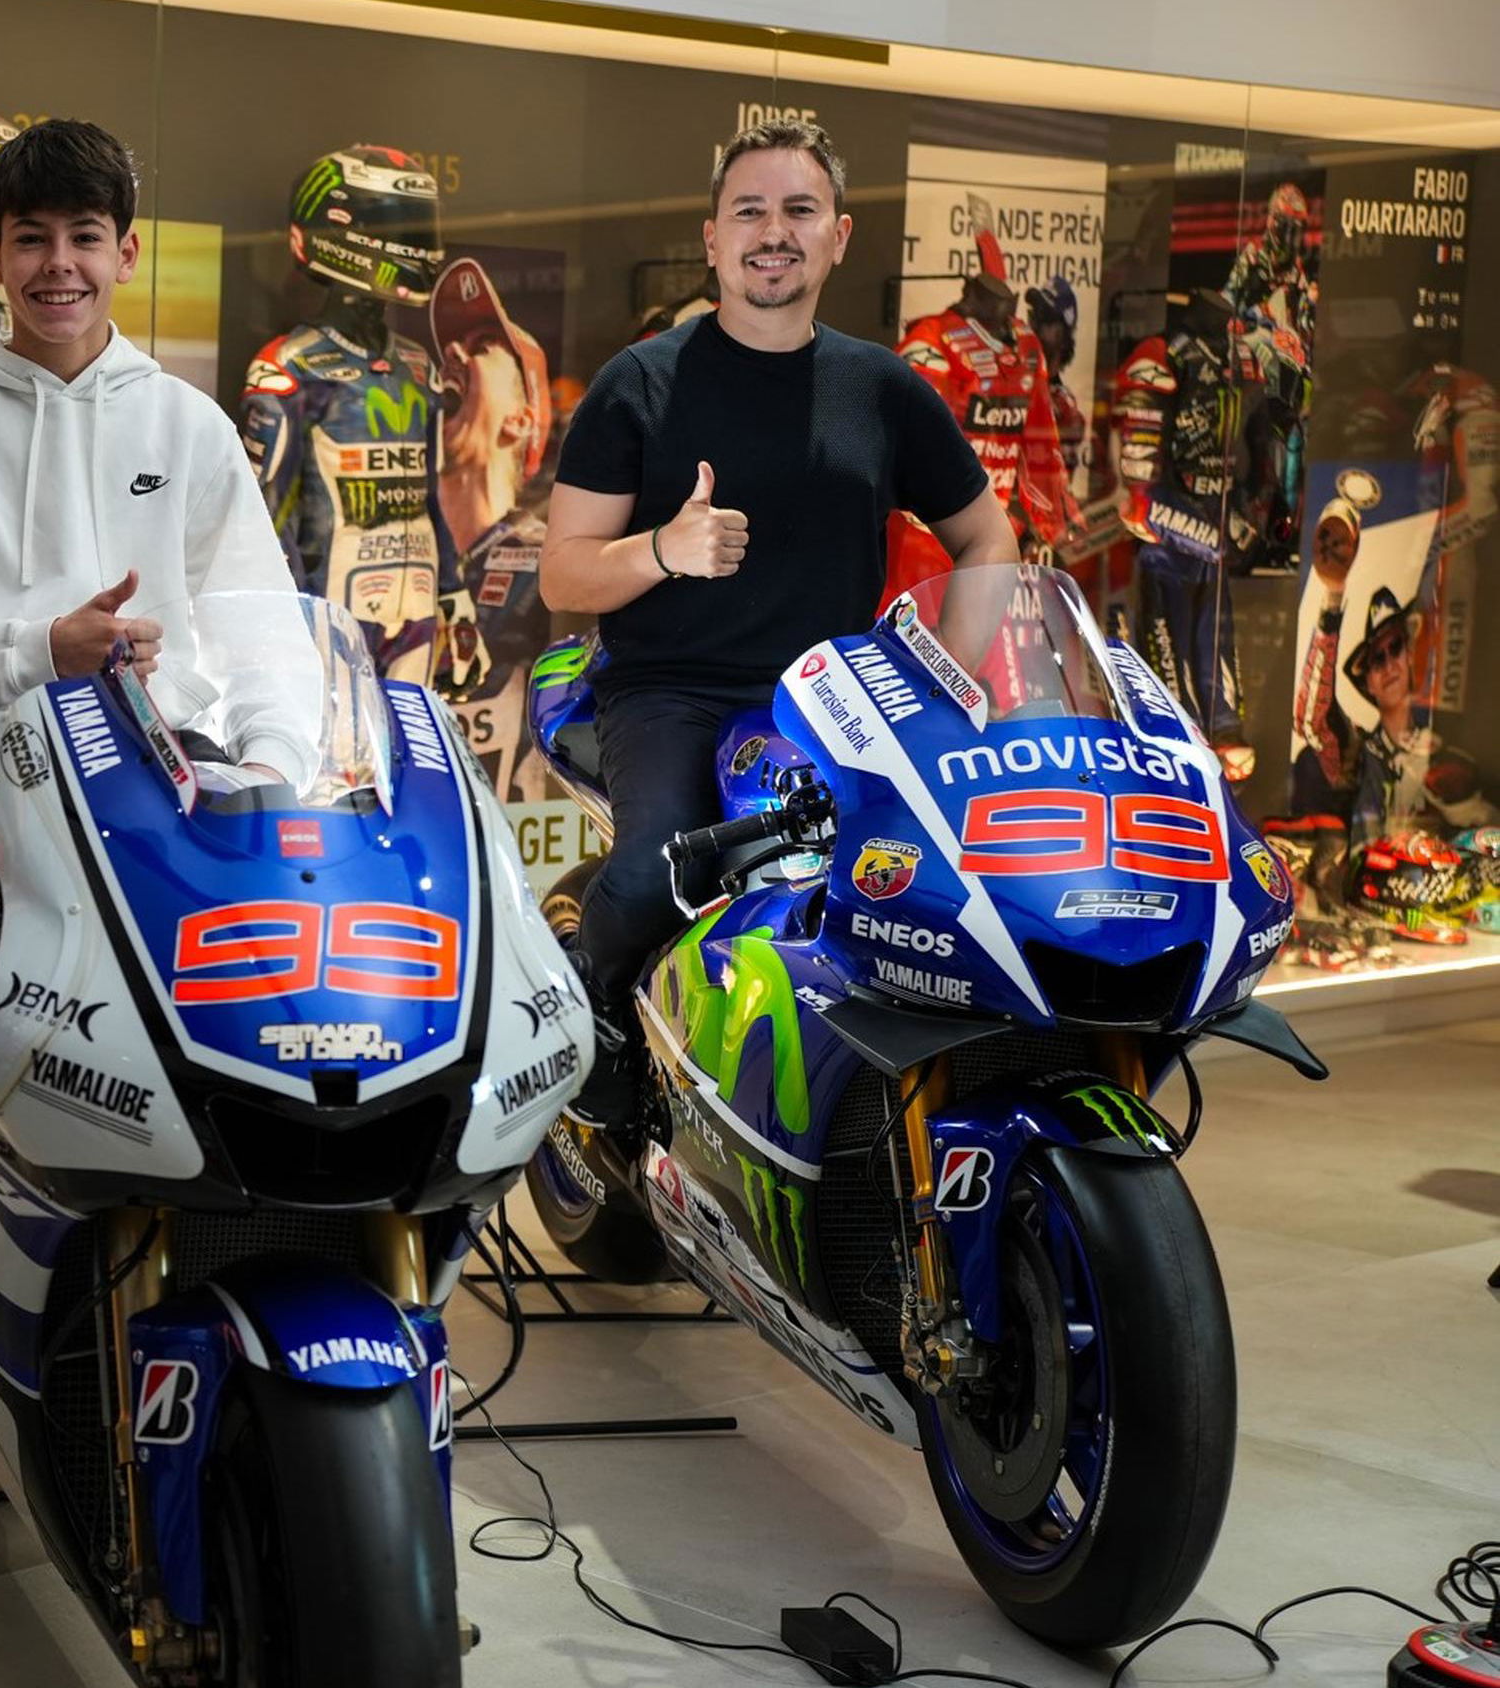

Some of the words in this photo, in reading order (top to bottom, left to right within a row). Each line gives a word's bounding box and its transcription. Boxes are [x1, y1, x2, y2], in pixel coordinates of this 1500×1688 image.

[1414, 167, 1468, 202] FABIO
[1341, 199, 1466, 239] QUARTARARO
[1150, 501, 1220, 548] YAMAHA
[843, 642, 925, 725] YAMAHA
[912, 630, 982, 709] JORGELORENZO99
[56, 685, 123, 780] YAMAHA
[387, 689, 450, 774] YAMAHA
[810, 672, 851, 727] Eurasian
[841, 716, 875, 755] Bank
[937, 736, 1190, 786] movistar
[867, 840, 919, 856] ABARTH
[958, 788, 1232, 883] 99
[1074, 906, 1157, 917] CORE
[1080, 893, 1163, 903] BLUE
[171, 900, 461, 1006] 99
[851, 912, 956, 957] ENEOS
[874, 957, 973, 1005] YAMALUBE
[278, 1040, 306, 1062] DI
[31, 1048, 155, 1124] YAMALUBE
[494, 1043, 579, 1117] YAMALUBE
[289, 1337, 415, 1378] YAMAHA
